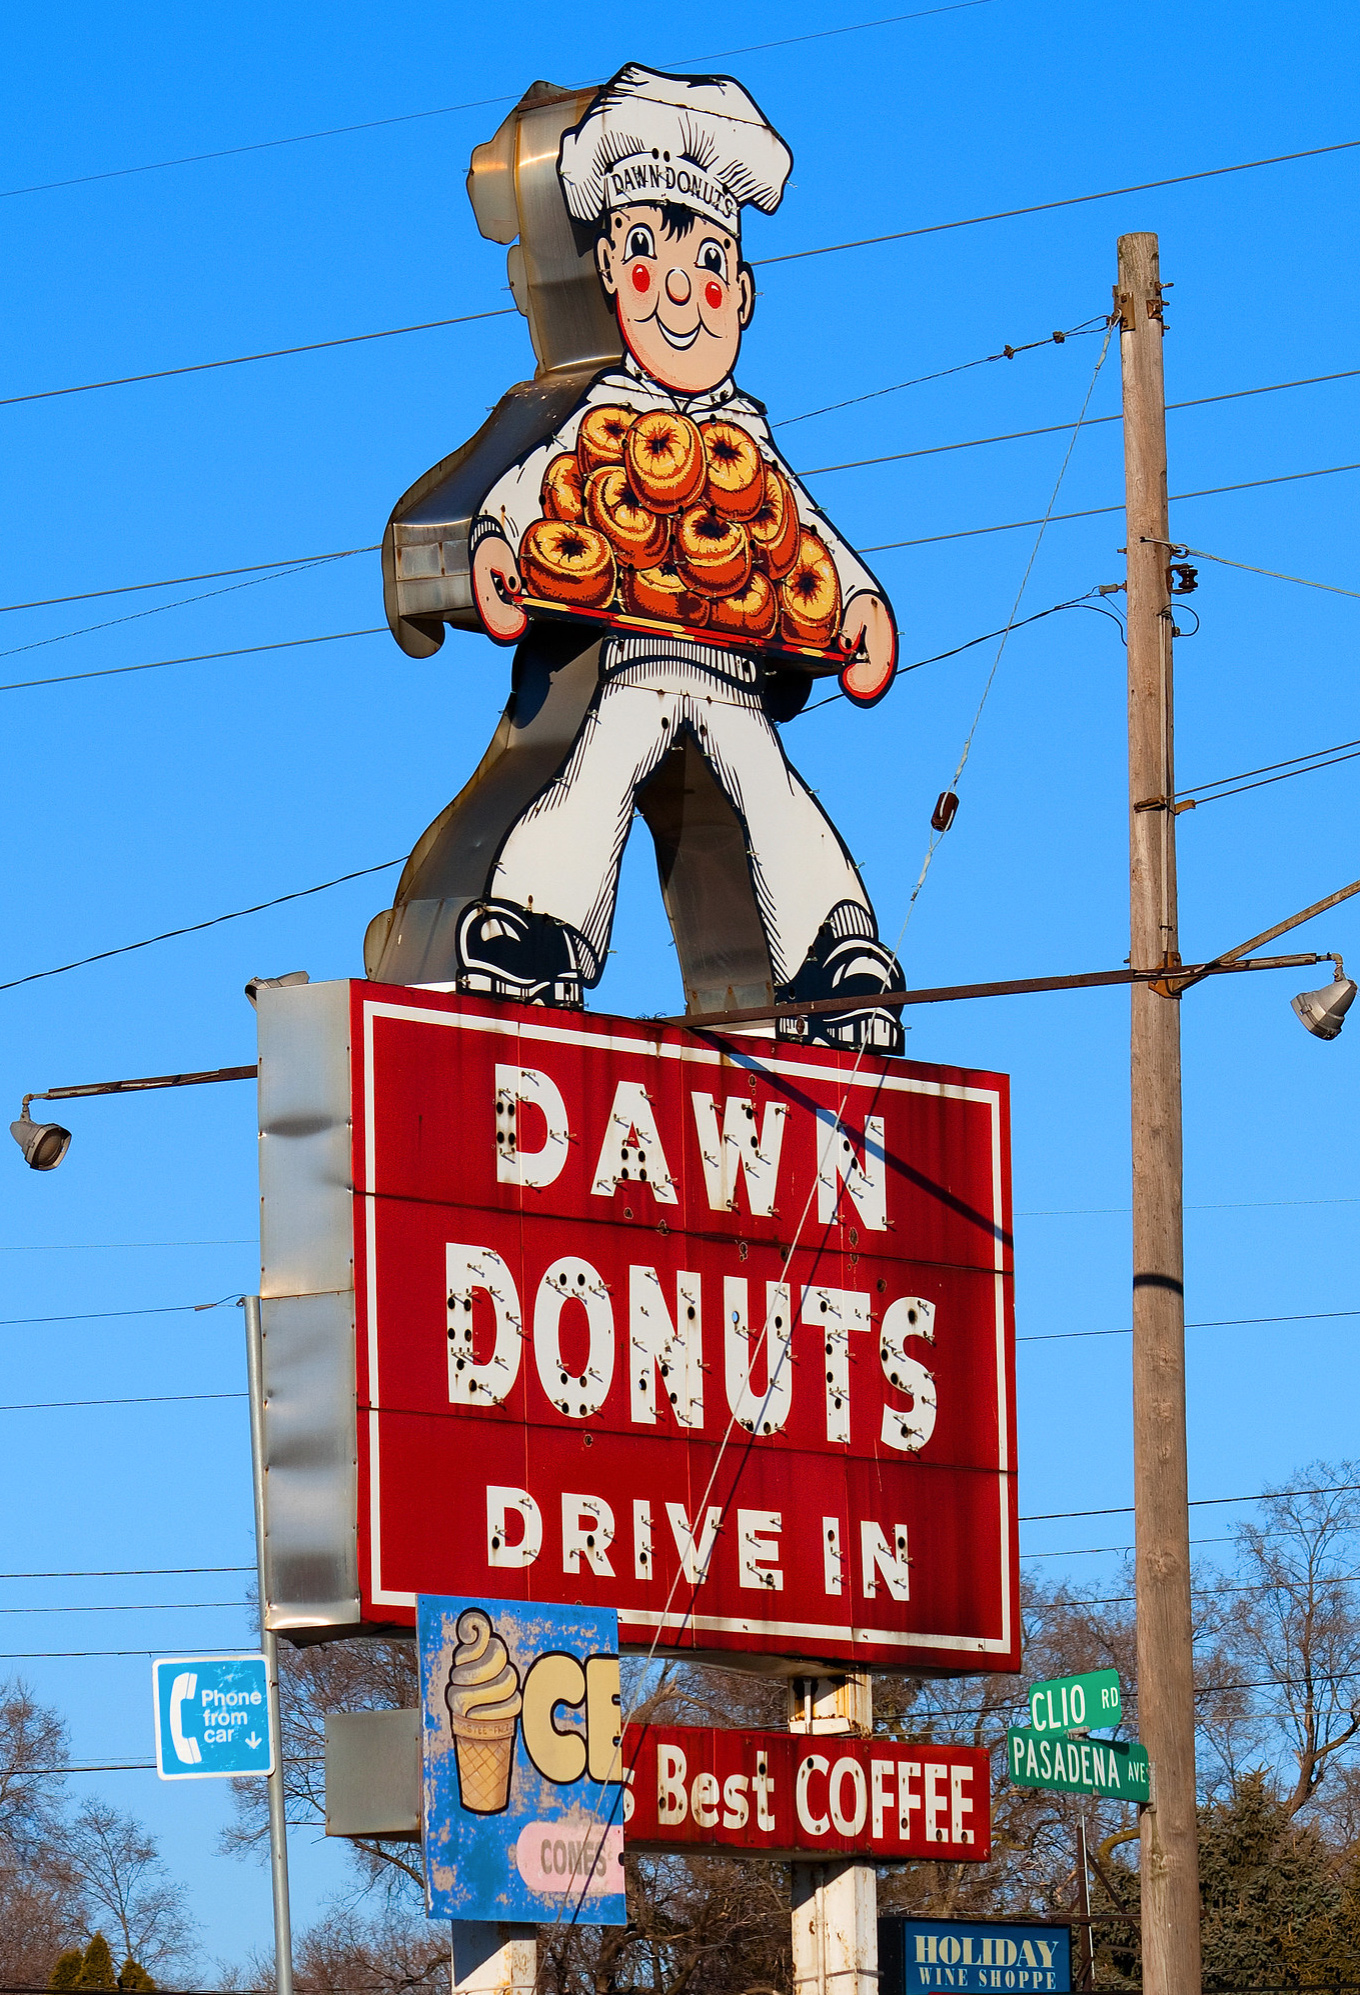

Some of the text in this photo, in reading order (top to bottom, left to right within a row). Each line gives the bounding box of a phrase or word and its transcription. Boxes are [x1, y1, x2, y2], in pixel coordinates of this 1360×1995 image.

[610, 164, 735, 219] DAWN DONUTS
[495, 1063, 887, 1231] DAWN
[446, 1242, 937, 1452] DONUTS
[486, 1485, 910, 1602] DRIVE IN
[202, 1689, 262, 1707] Phone
[203, 1709, 248, 1727] from
[1032, 1684, 1119, 1732] CLIO RD
[204, 1728, 235, 1743] car
[1013, 1736, 1146, 1788] PASADENA AVE
[657, 1743, 776, 1832] Best
[796, 1754, 975, 1845] COFFEE
[914, 1935, 1059, 1968] HOLIDAY
[918, 1966, 1057, 1990] WINE SHOPPE
